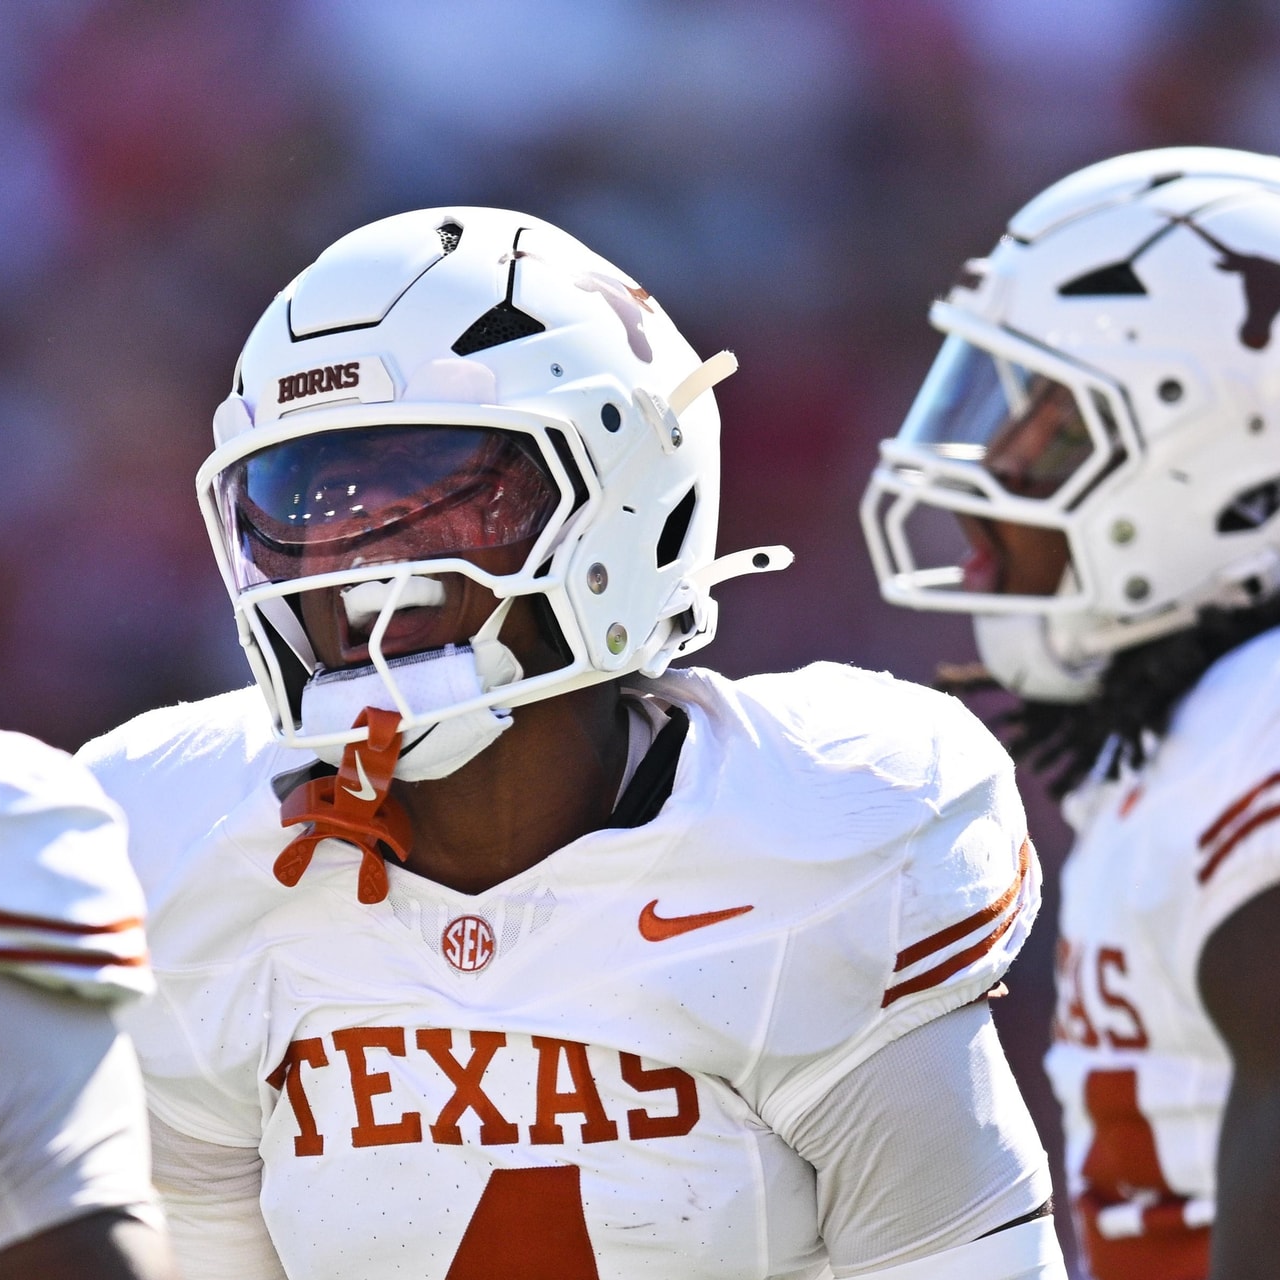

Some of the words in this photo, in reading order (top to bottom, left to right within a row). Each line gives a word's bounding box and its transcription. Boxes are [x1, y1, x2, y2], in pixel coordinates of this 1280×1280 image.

[277, 361, 360, 404] HORNS
[443, 915, 496, 971] SEC
[266, 1026, 700, 1157] TEXAS
